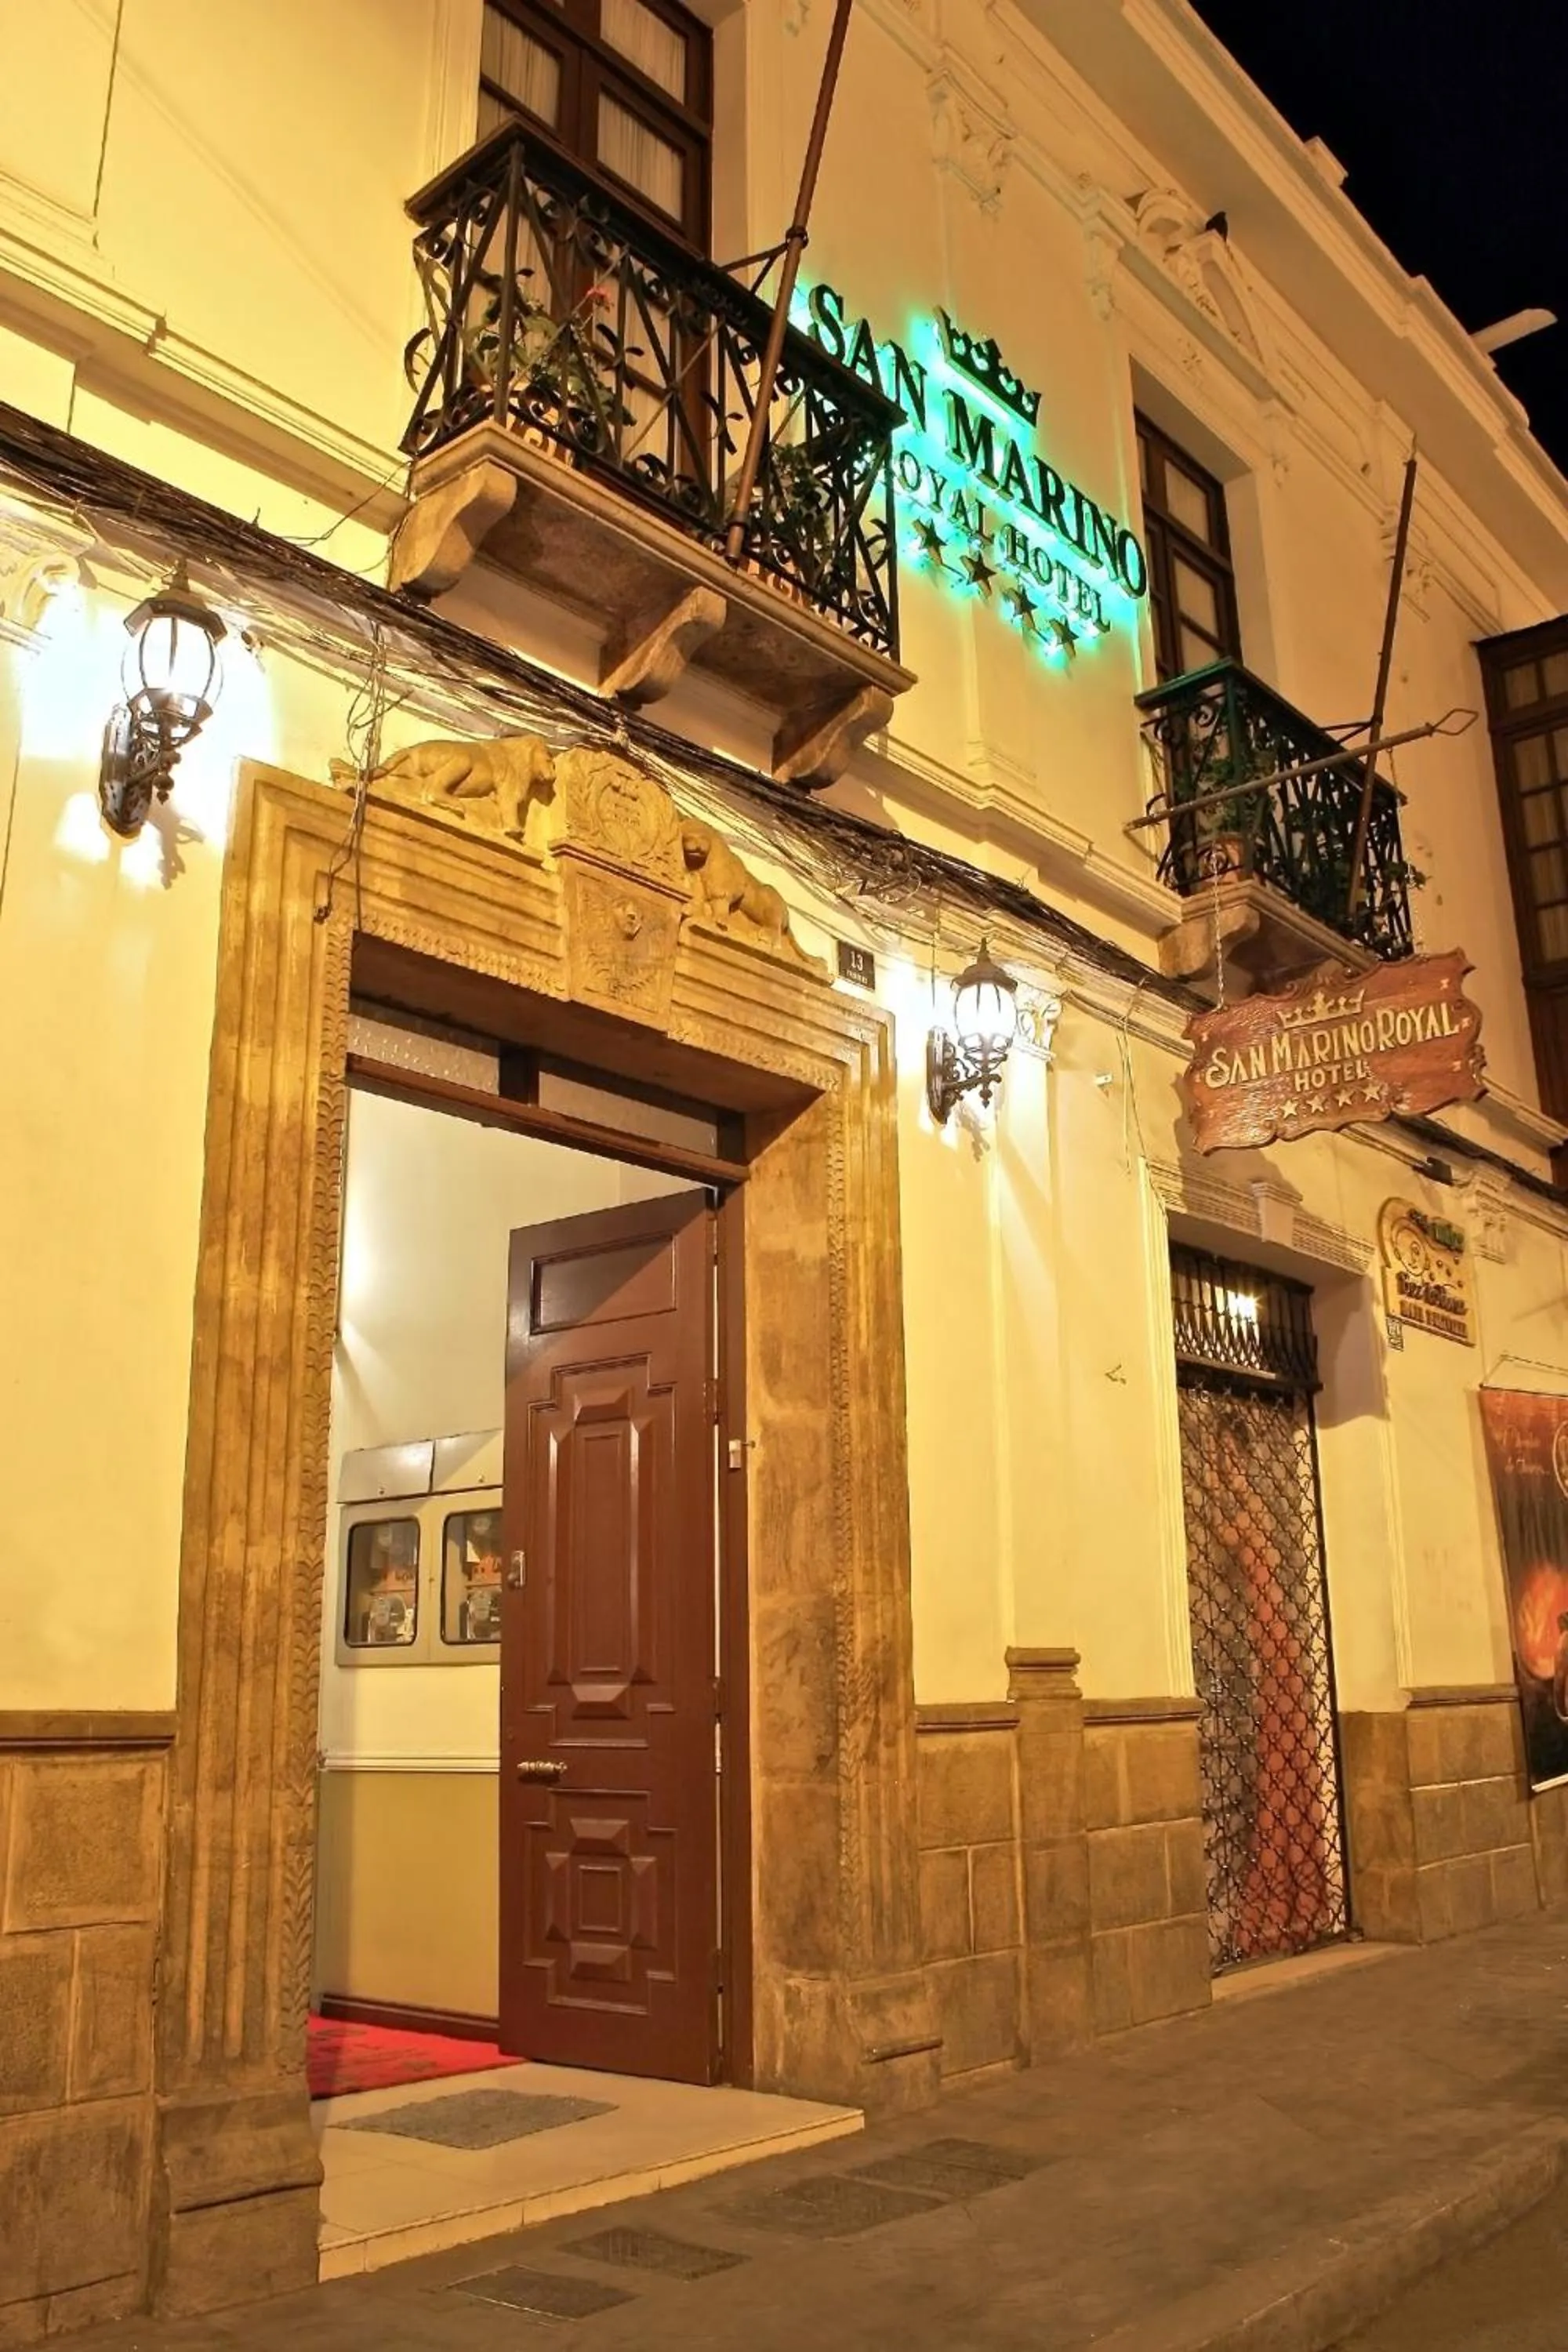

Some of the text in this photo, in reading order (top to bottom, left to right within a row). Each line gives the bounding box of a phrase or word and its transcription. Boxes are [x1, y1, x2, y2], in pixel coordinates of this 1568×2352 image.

[808, 283, 1147, 600] SAN MARINO
[894, 448, 1111, 633] OYAL HOTEL
[1204, 1001, 1461, 1089] SAN MARINO ROYAL
[1294, 1060, 1370, 1093] HOTEL
